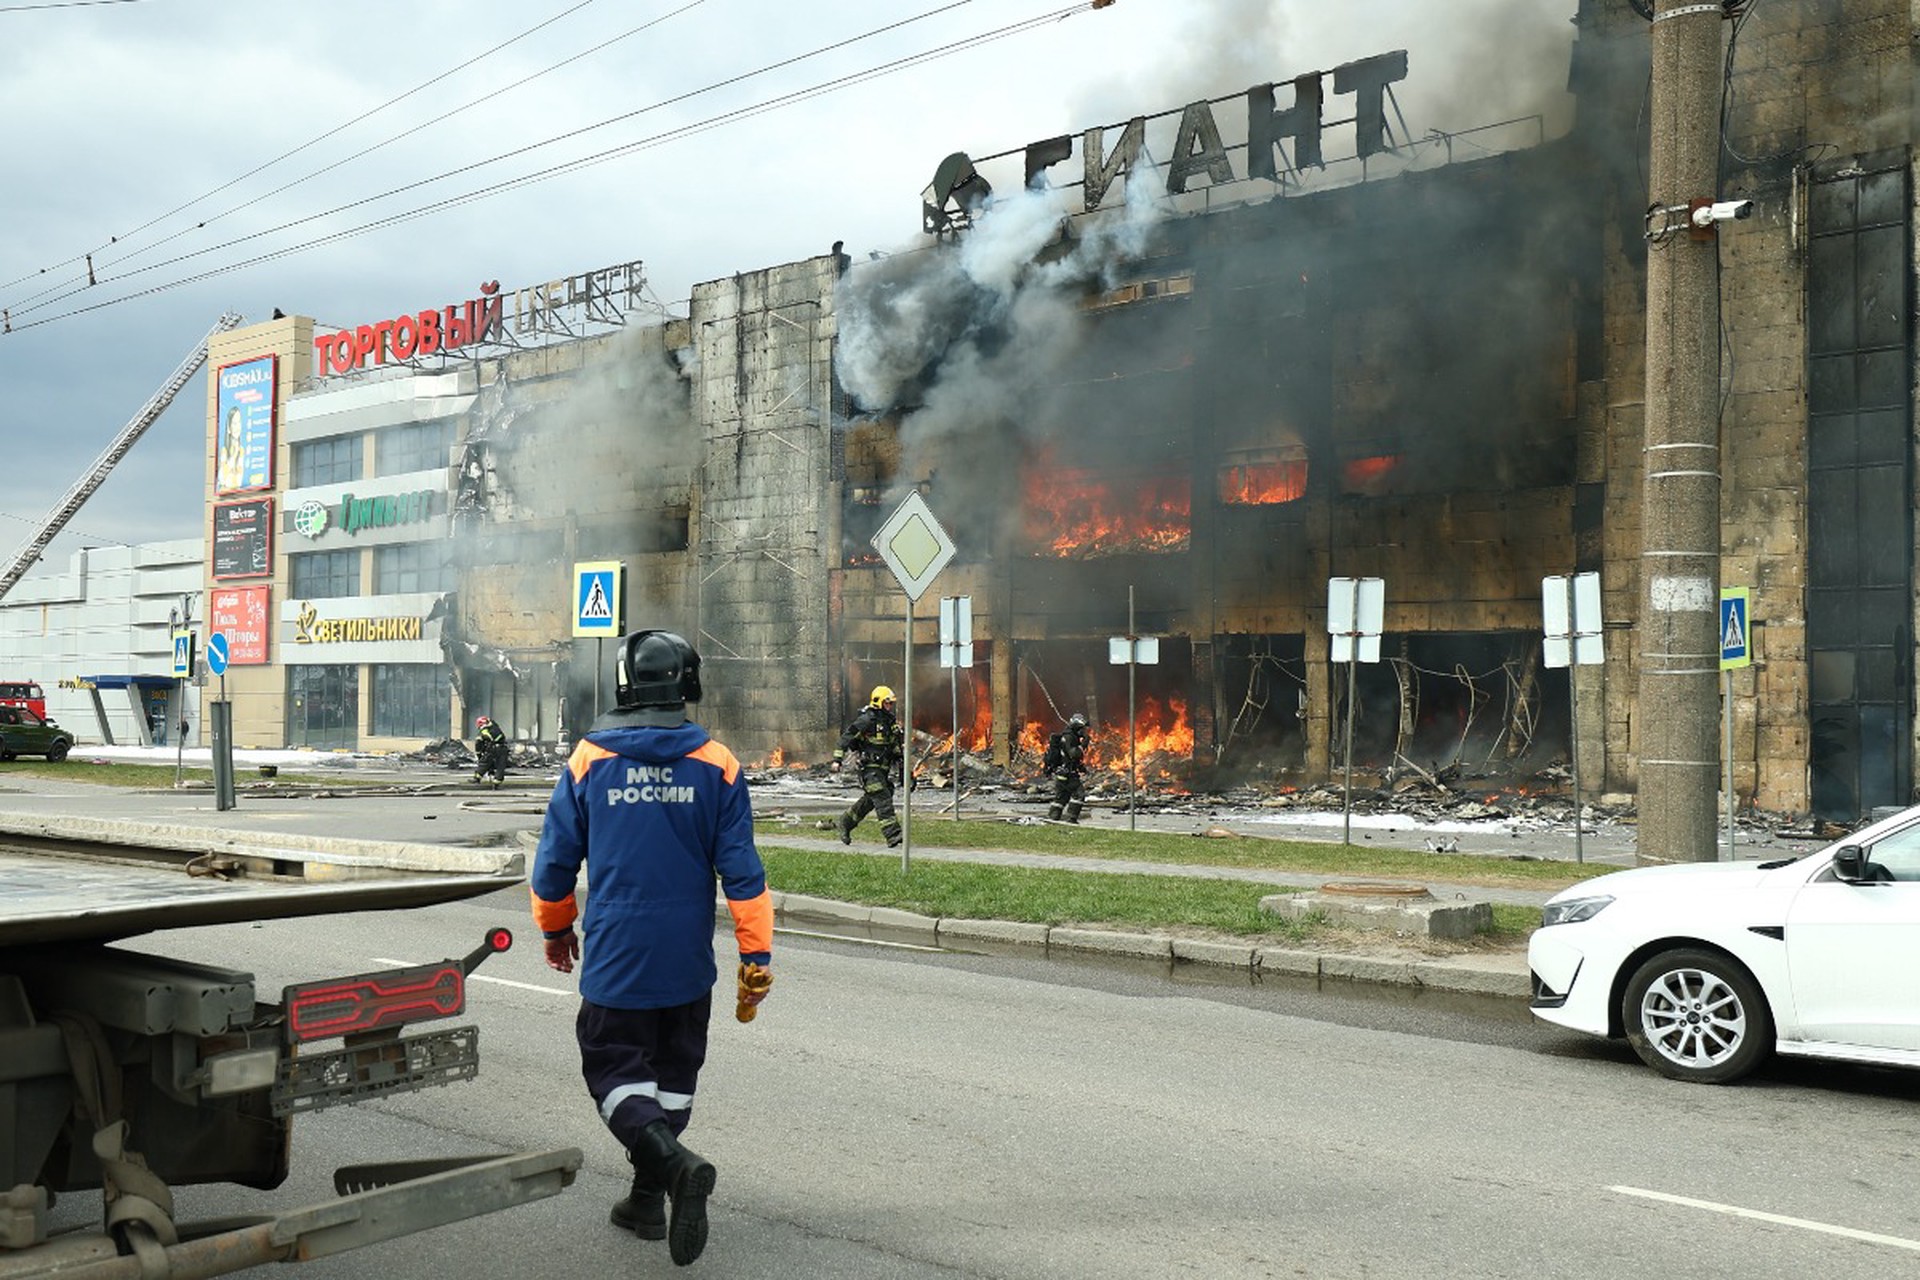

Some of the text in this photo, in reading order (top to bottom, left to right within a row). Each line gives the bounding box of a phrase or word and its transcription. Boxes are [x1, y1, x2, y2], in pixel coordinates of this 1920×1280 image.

[314, 279, 503, 377] ТОРГОВЫЙ
[313, 616, 422, 643] СВЕТИЛЬНИКИ
[626, 766, 673, 785] МЧС
[607, 785, 694, 806] РОССИИ
